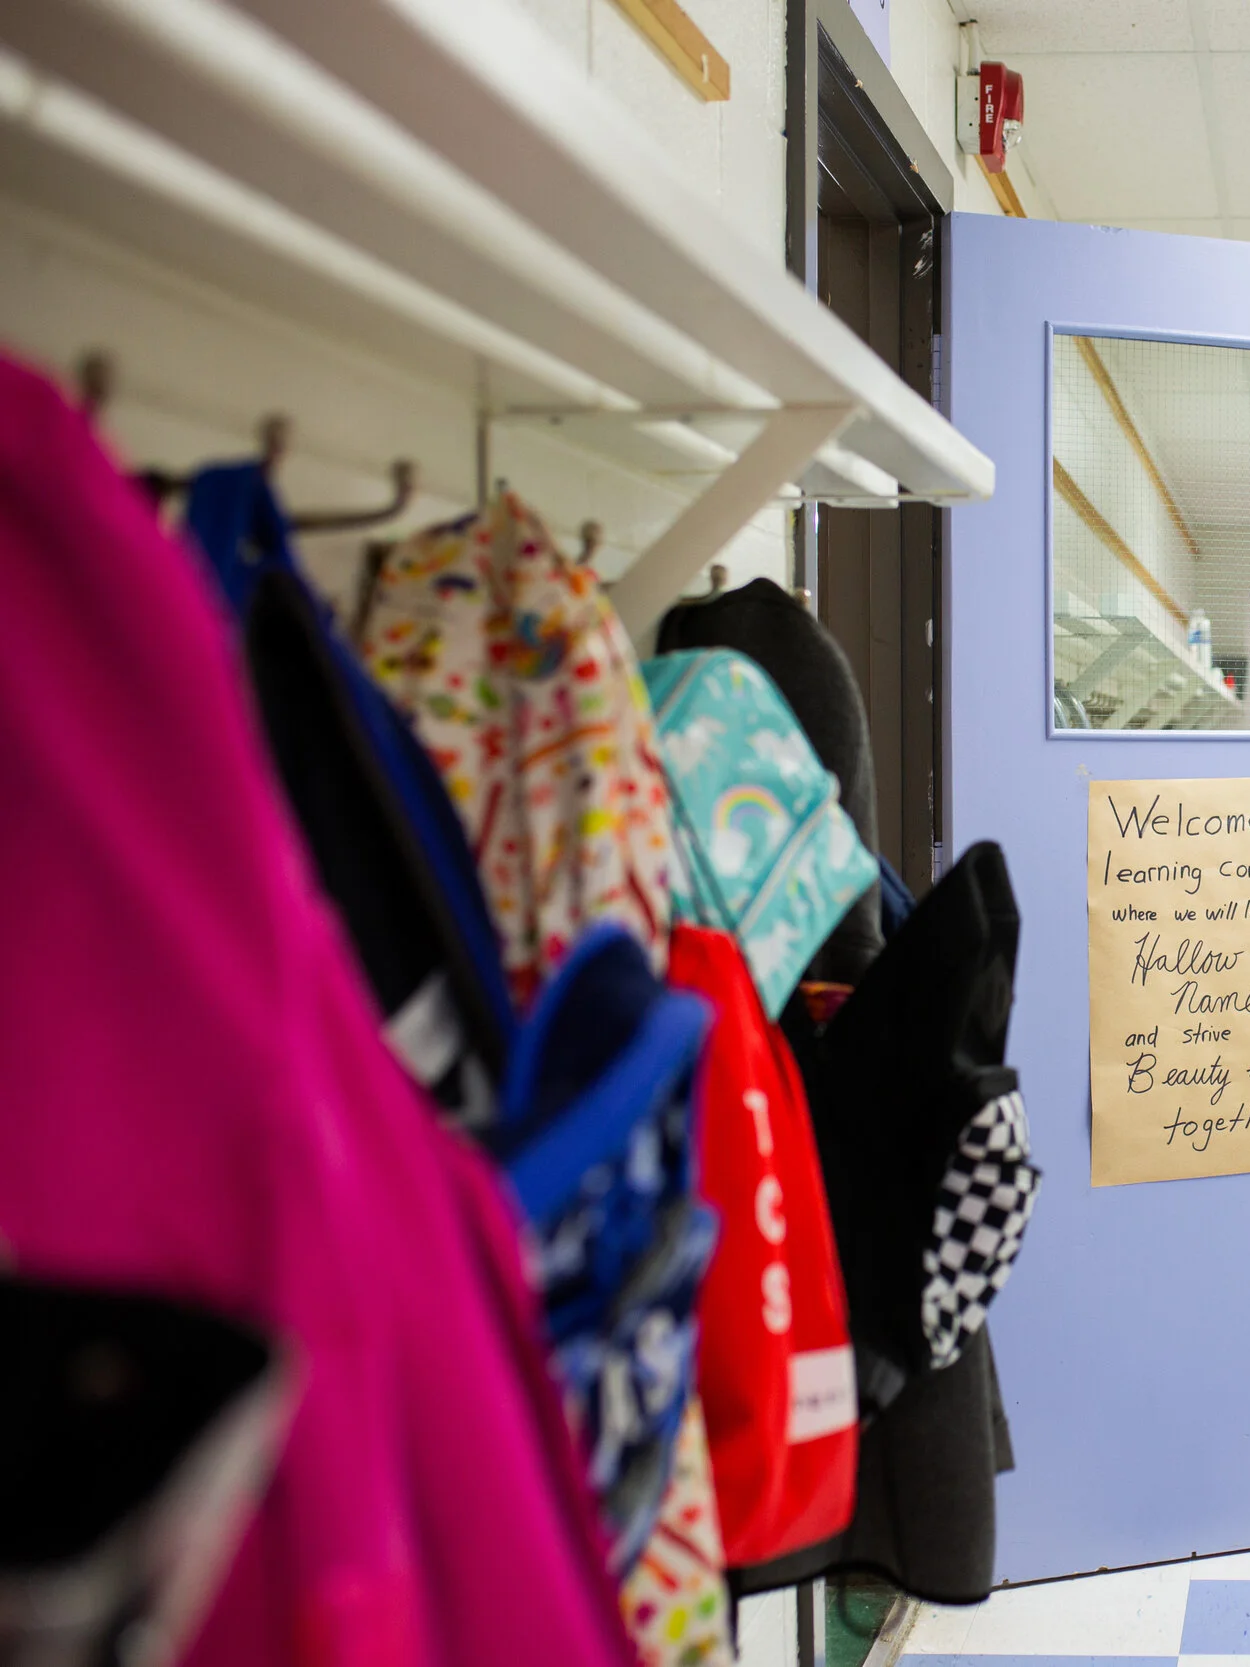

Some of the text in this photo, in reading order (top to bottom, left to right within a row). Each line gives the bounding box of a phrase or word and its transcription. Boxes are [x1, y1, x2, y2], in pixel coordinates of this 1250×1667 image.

[985, 84, 994, 124] FIRE
[1104, 849, 1202, 895] learning
[1111, 903, 1158, 923] where
[1174, 908, 1197, 922] we
[1205, 900, 1238, 921] will
[1131, 931, 1245, 987] Hallow
[1124, 1024, 1159, 1048] and
[1181, 1022, 1232, 1045] strive
[1125, 1051, 1232, 1106] Beauty
